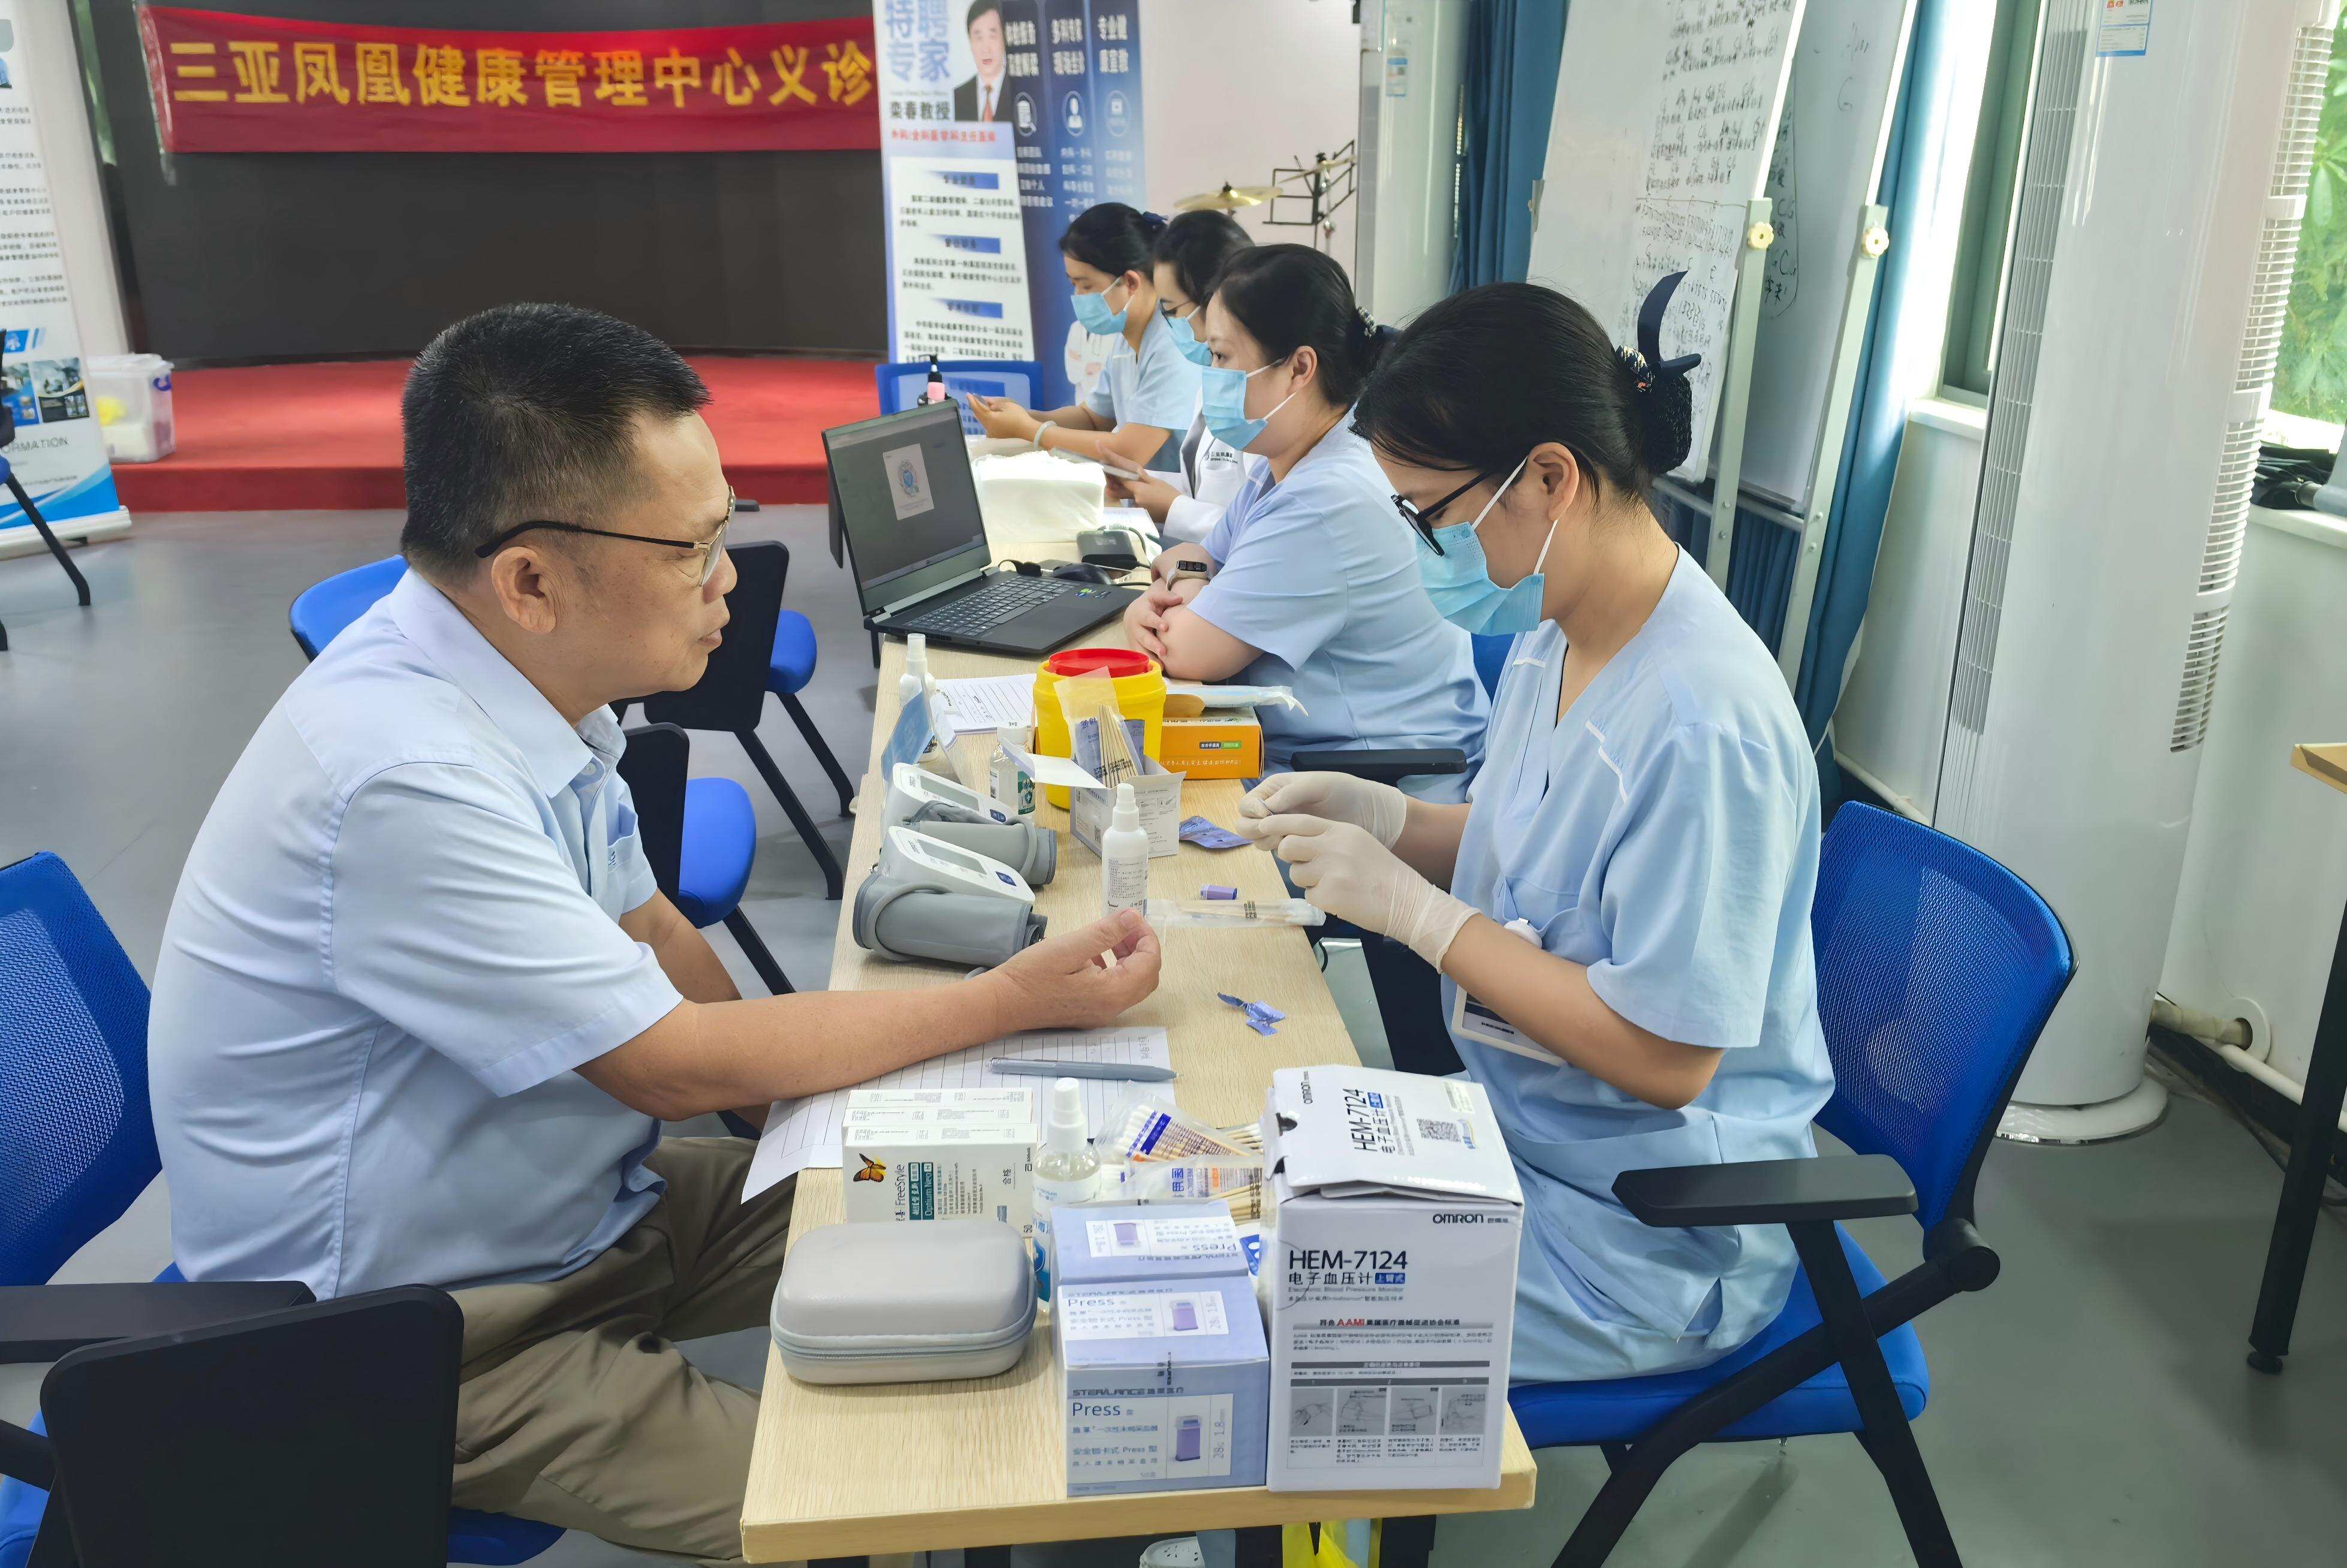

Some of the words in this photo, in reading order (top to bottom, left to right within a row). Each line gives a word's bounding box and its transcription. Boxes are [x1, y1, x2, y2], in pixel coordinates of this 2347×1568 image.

[170, 40, 874, 108] 三亚凤凰健康管理中心义诊
[887, 39, 951, 82] 专家
[1342, 1088, 1378, 1152] HEM-7124
[1289, 1250, 1408, 1270] HEM-7124
[1289, 1271, 1372, 1285] 电子血压计
[1072, 1402, 1120, 1416] Press
